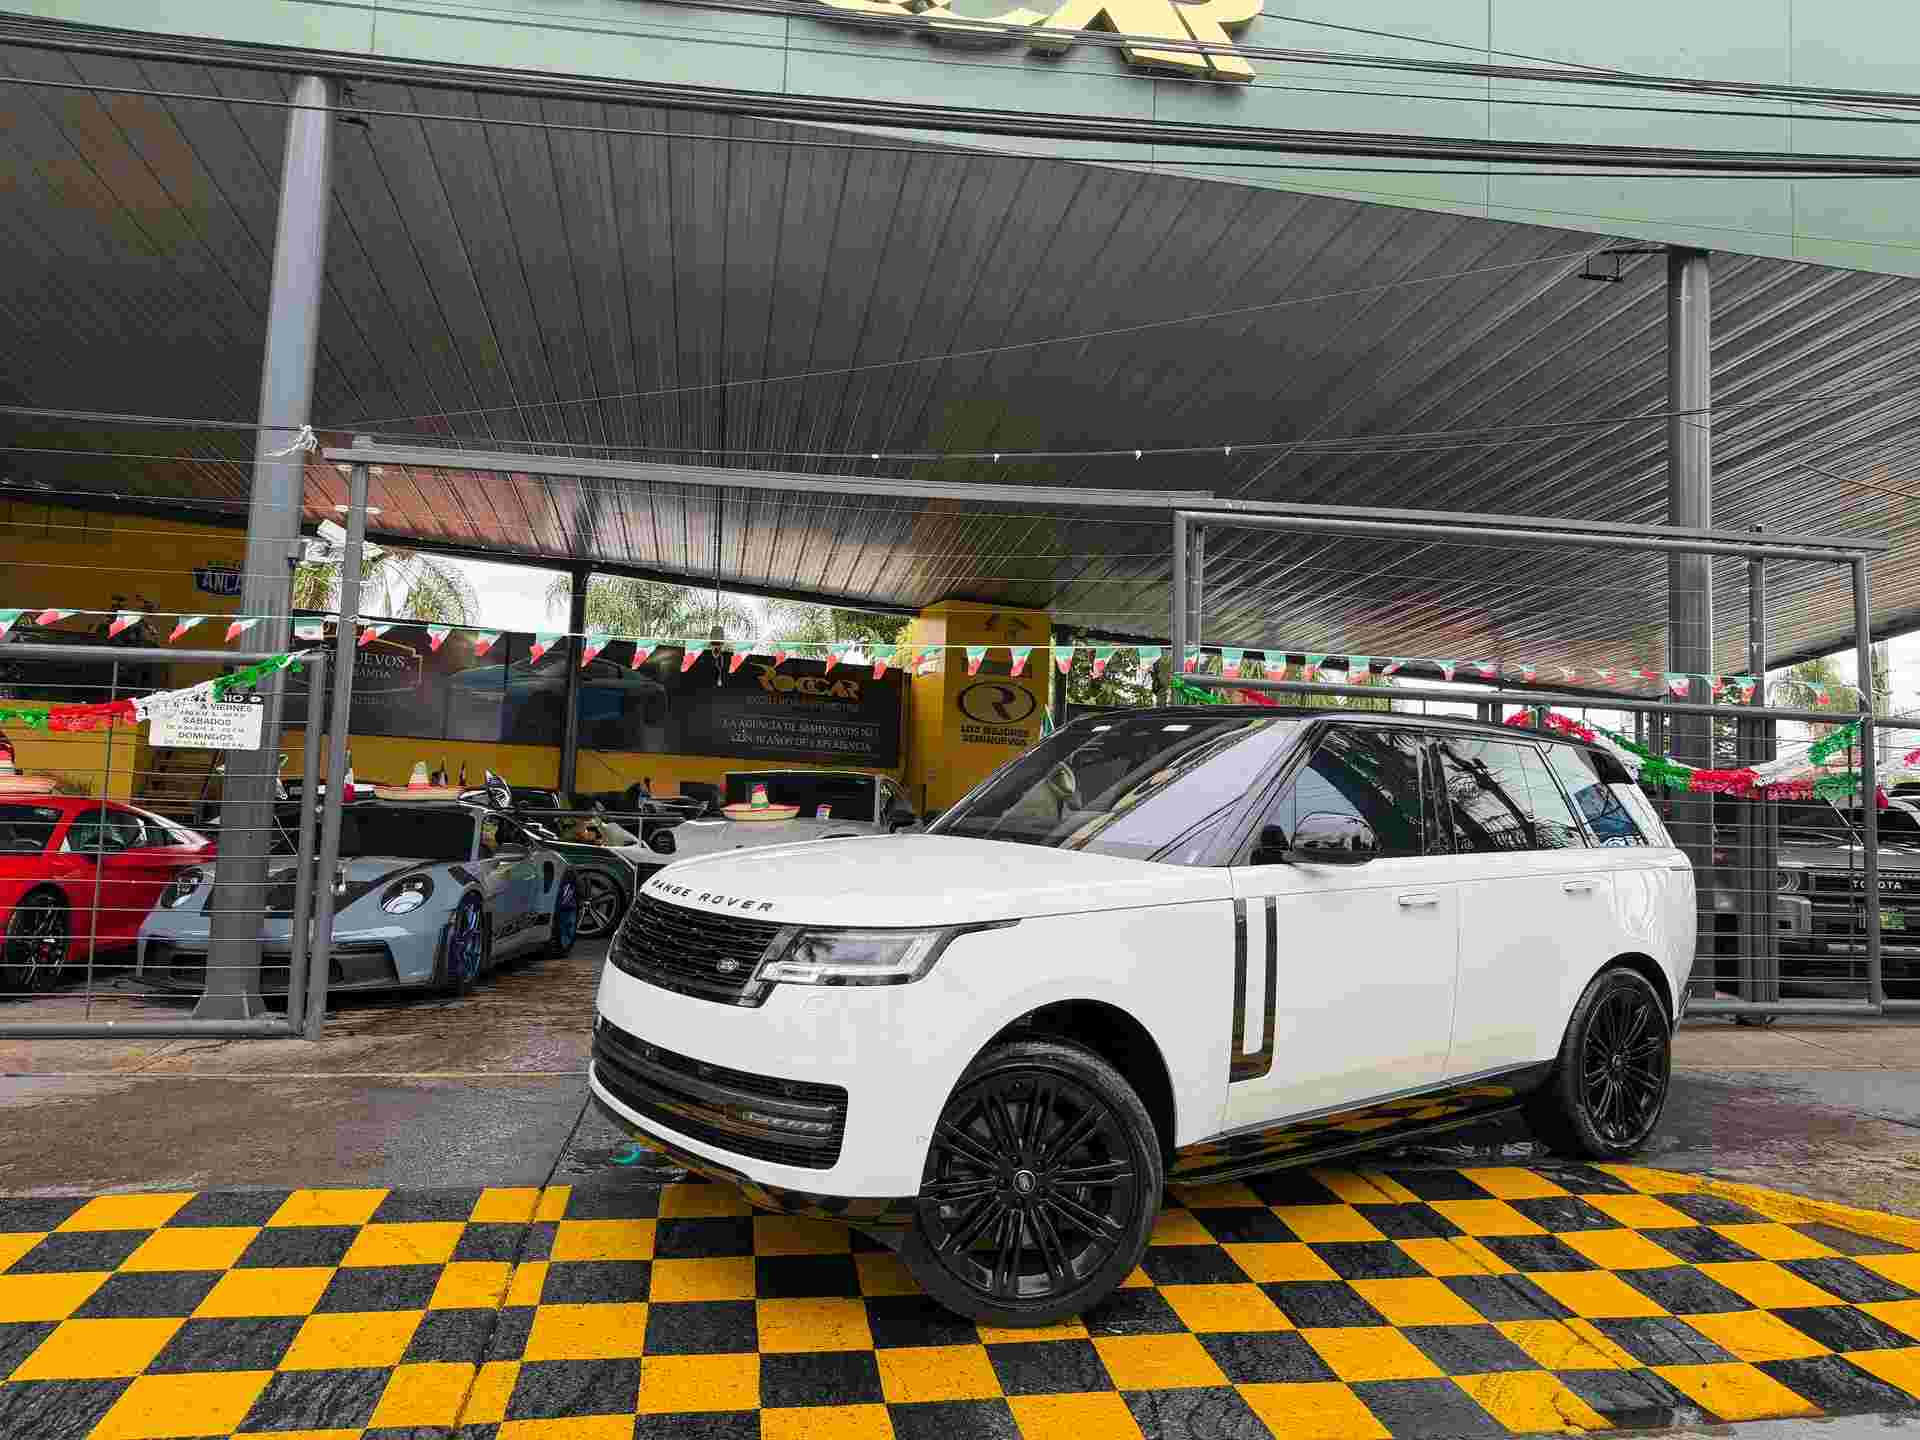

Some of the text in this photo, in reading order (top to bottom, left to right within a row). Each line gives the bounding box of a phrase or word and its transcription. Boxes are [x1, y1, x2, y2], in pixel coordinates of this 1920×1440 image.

[651, 879, 773, 912] RANGE ROVER
[1852, 879, 1902, 890] TOOTA
